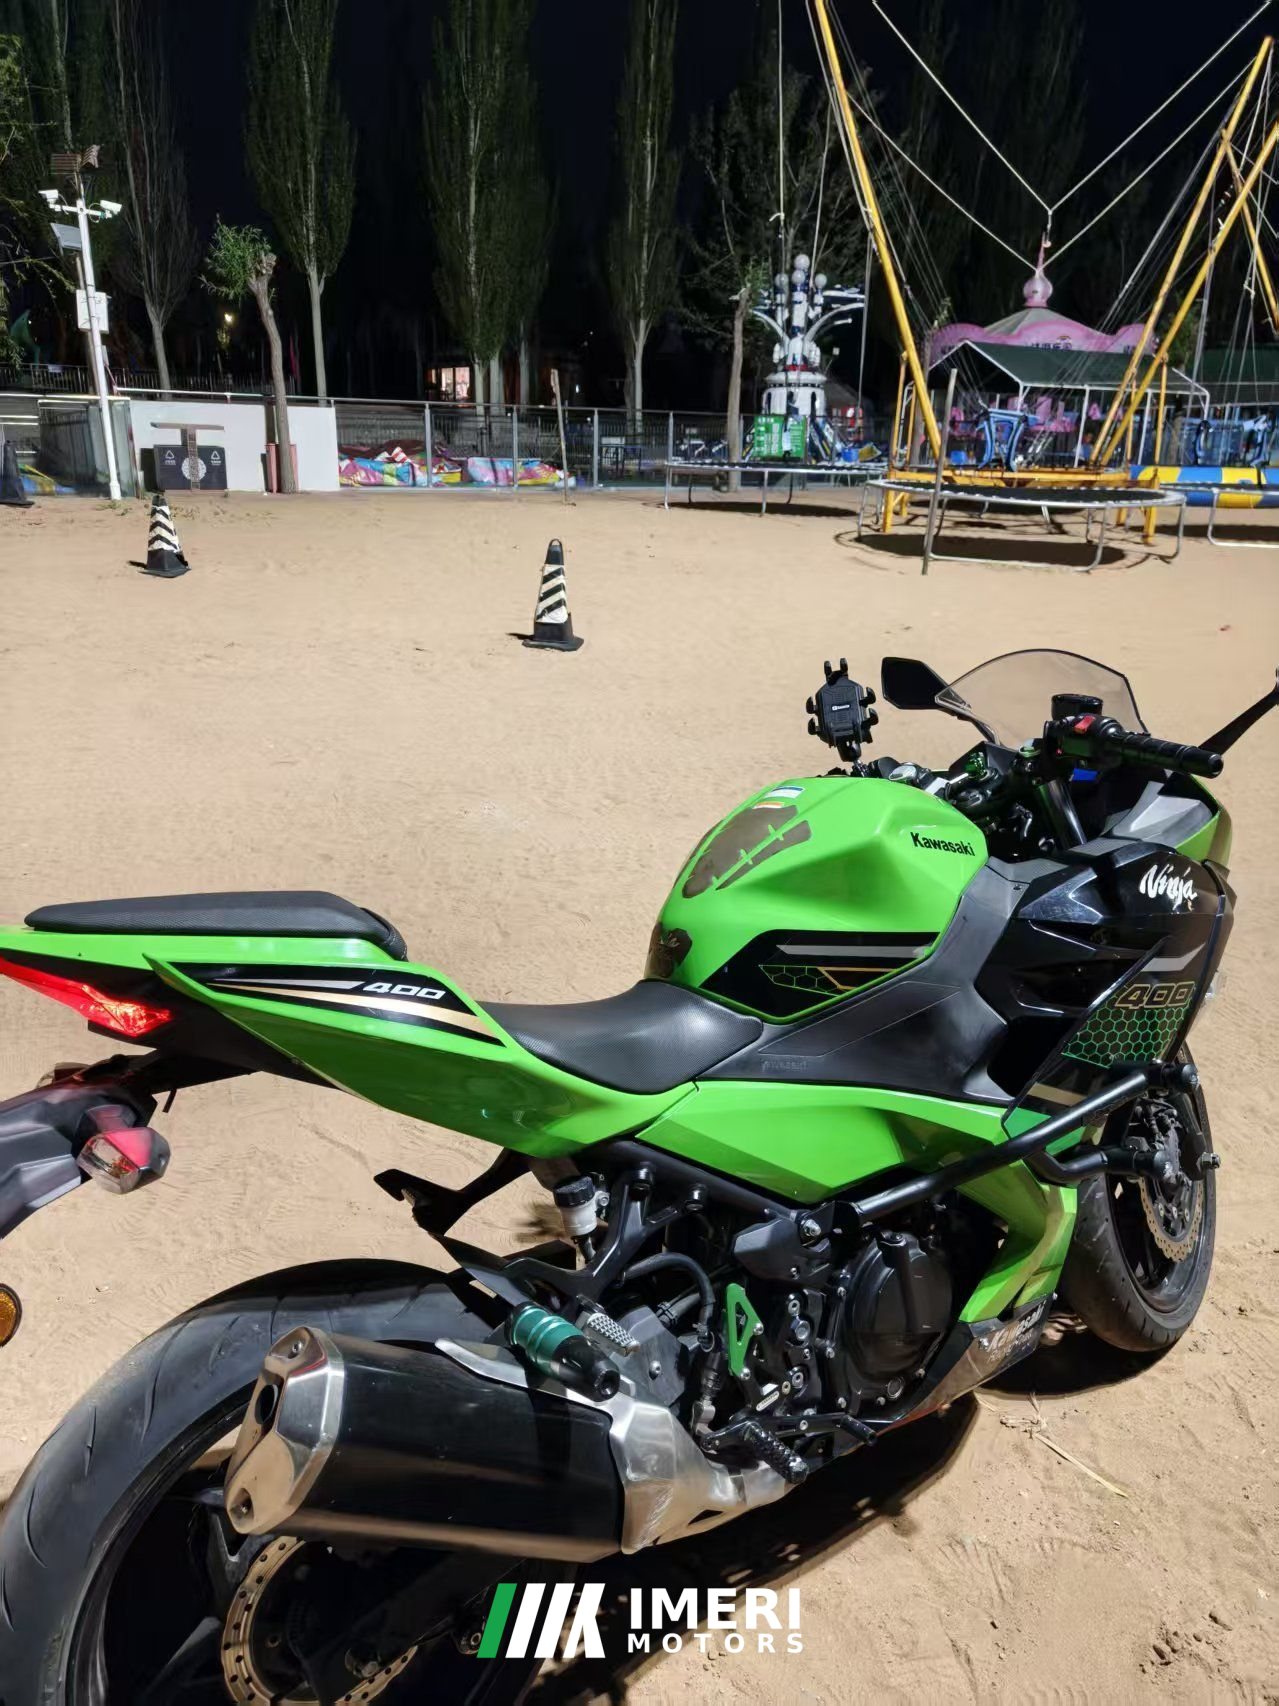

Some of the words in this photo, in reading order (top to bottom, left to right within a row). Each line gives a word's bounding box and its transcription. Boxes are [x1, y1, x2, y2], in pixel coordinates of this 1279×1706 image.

[910, 831, 976, 857] Kawasaki
[1139, 863, 1198, 912] Ninja
[362, 982, 446, 1000] 400
[1114, 981, 1196, 1009] 400
